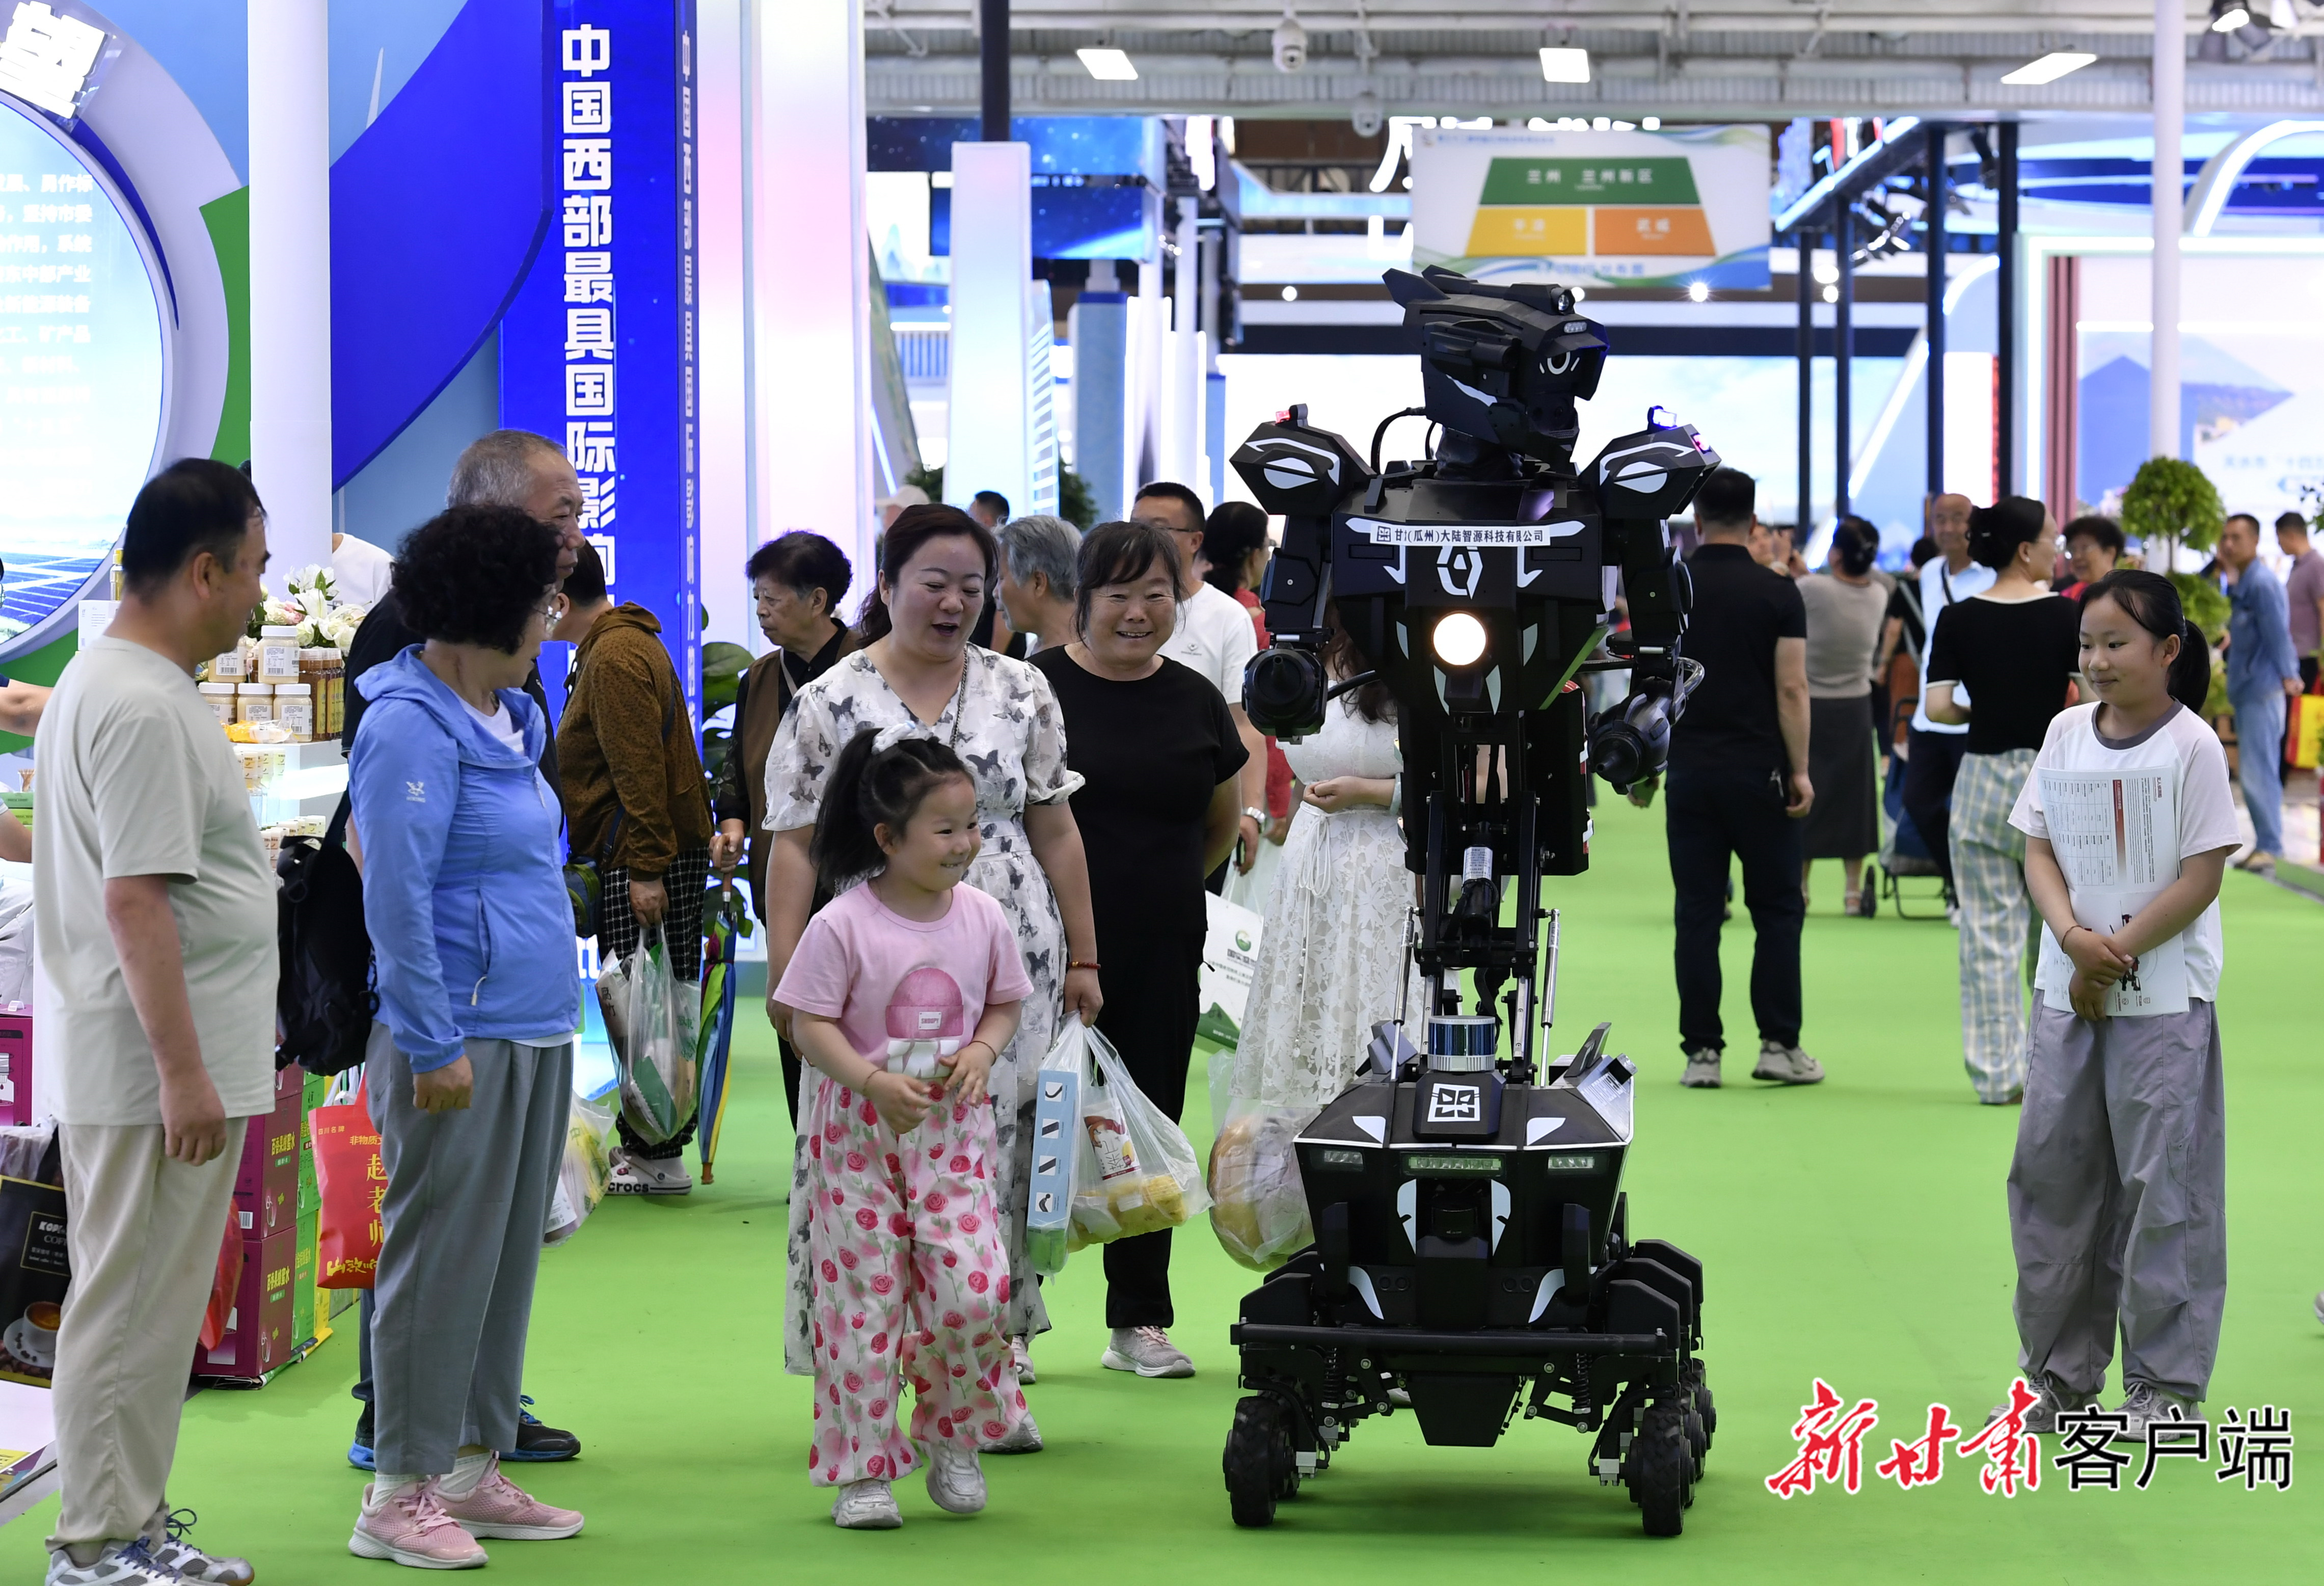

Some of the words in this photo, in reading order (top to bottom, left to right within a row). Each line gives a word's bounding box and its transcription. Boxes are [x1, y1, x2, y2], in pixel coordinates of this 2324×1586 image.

[0, 294, 91, 313] 新能源装备
[0, 325, 91, 343] 工、矿产品
[318, 1125, 345, 1135] 四川名牌
[608, 1182, 649, 1193] crocs
